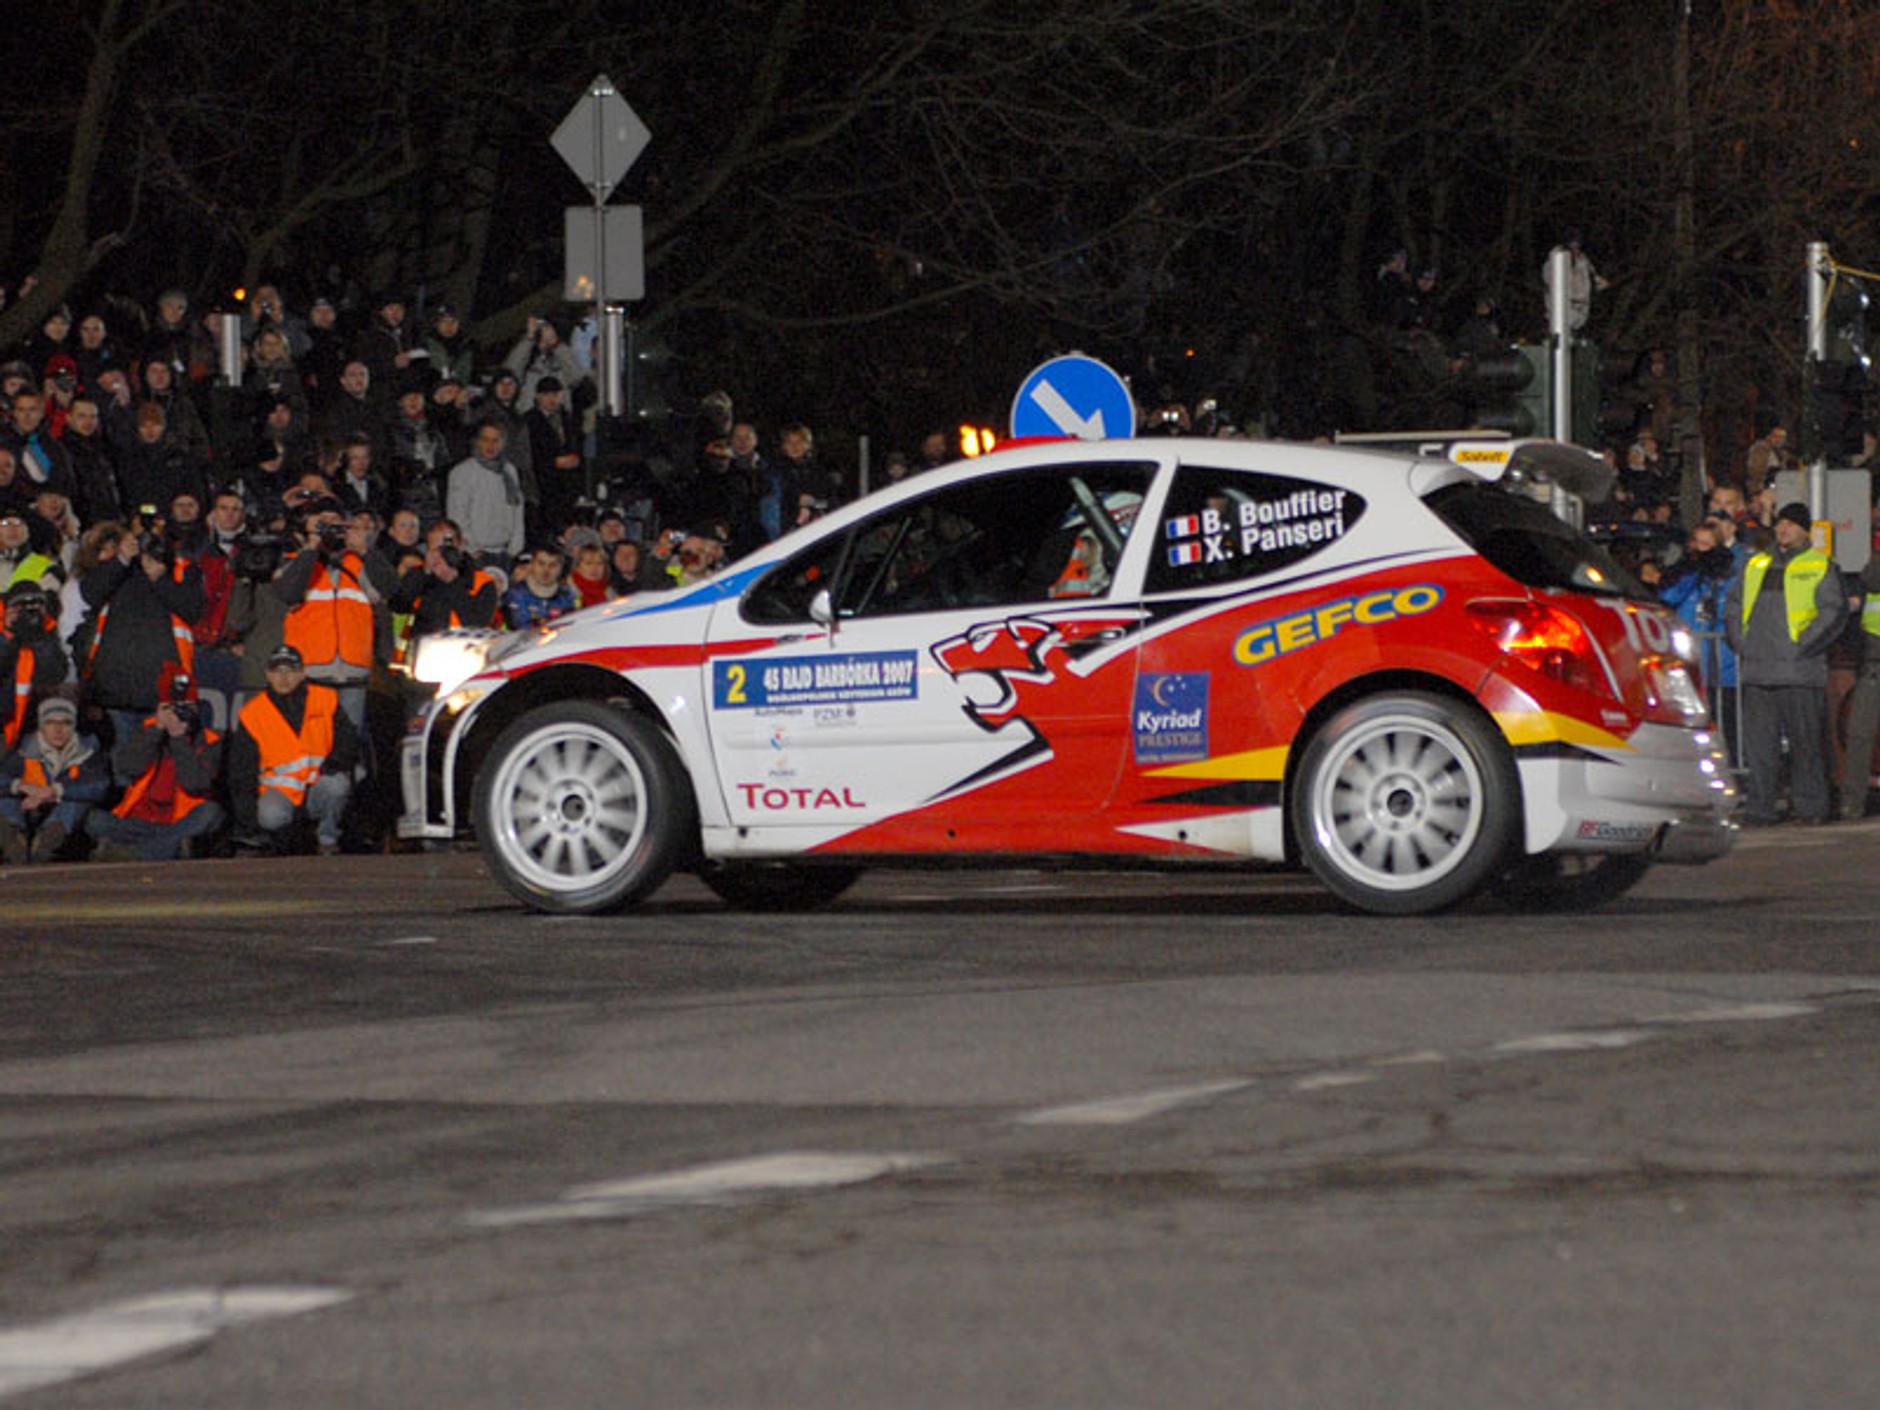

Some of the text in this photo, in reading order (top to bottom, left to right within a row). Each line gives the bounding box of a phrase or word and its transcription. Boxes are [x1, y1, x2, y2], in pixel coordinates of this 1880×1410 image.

[1201, 489, 1345, 534] B. Bouffier
[1203, 511, 1343, 563] X. Panseri
[1232, 583, 1443, 668] GEFCO
[727, 665, 746, 703] 2
[764, 667, 779, 691] 45
[882, 660, 913, 685] 2007
[1137, 707, 1202, 734] Kyriad
[1138, 731, 1202, 748] PRESTIGE
[736, 783, 866, 810] TOTAL
